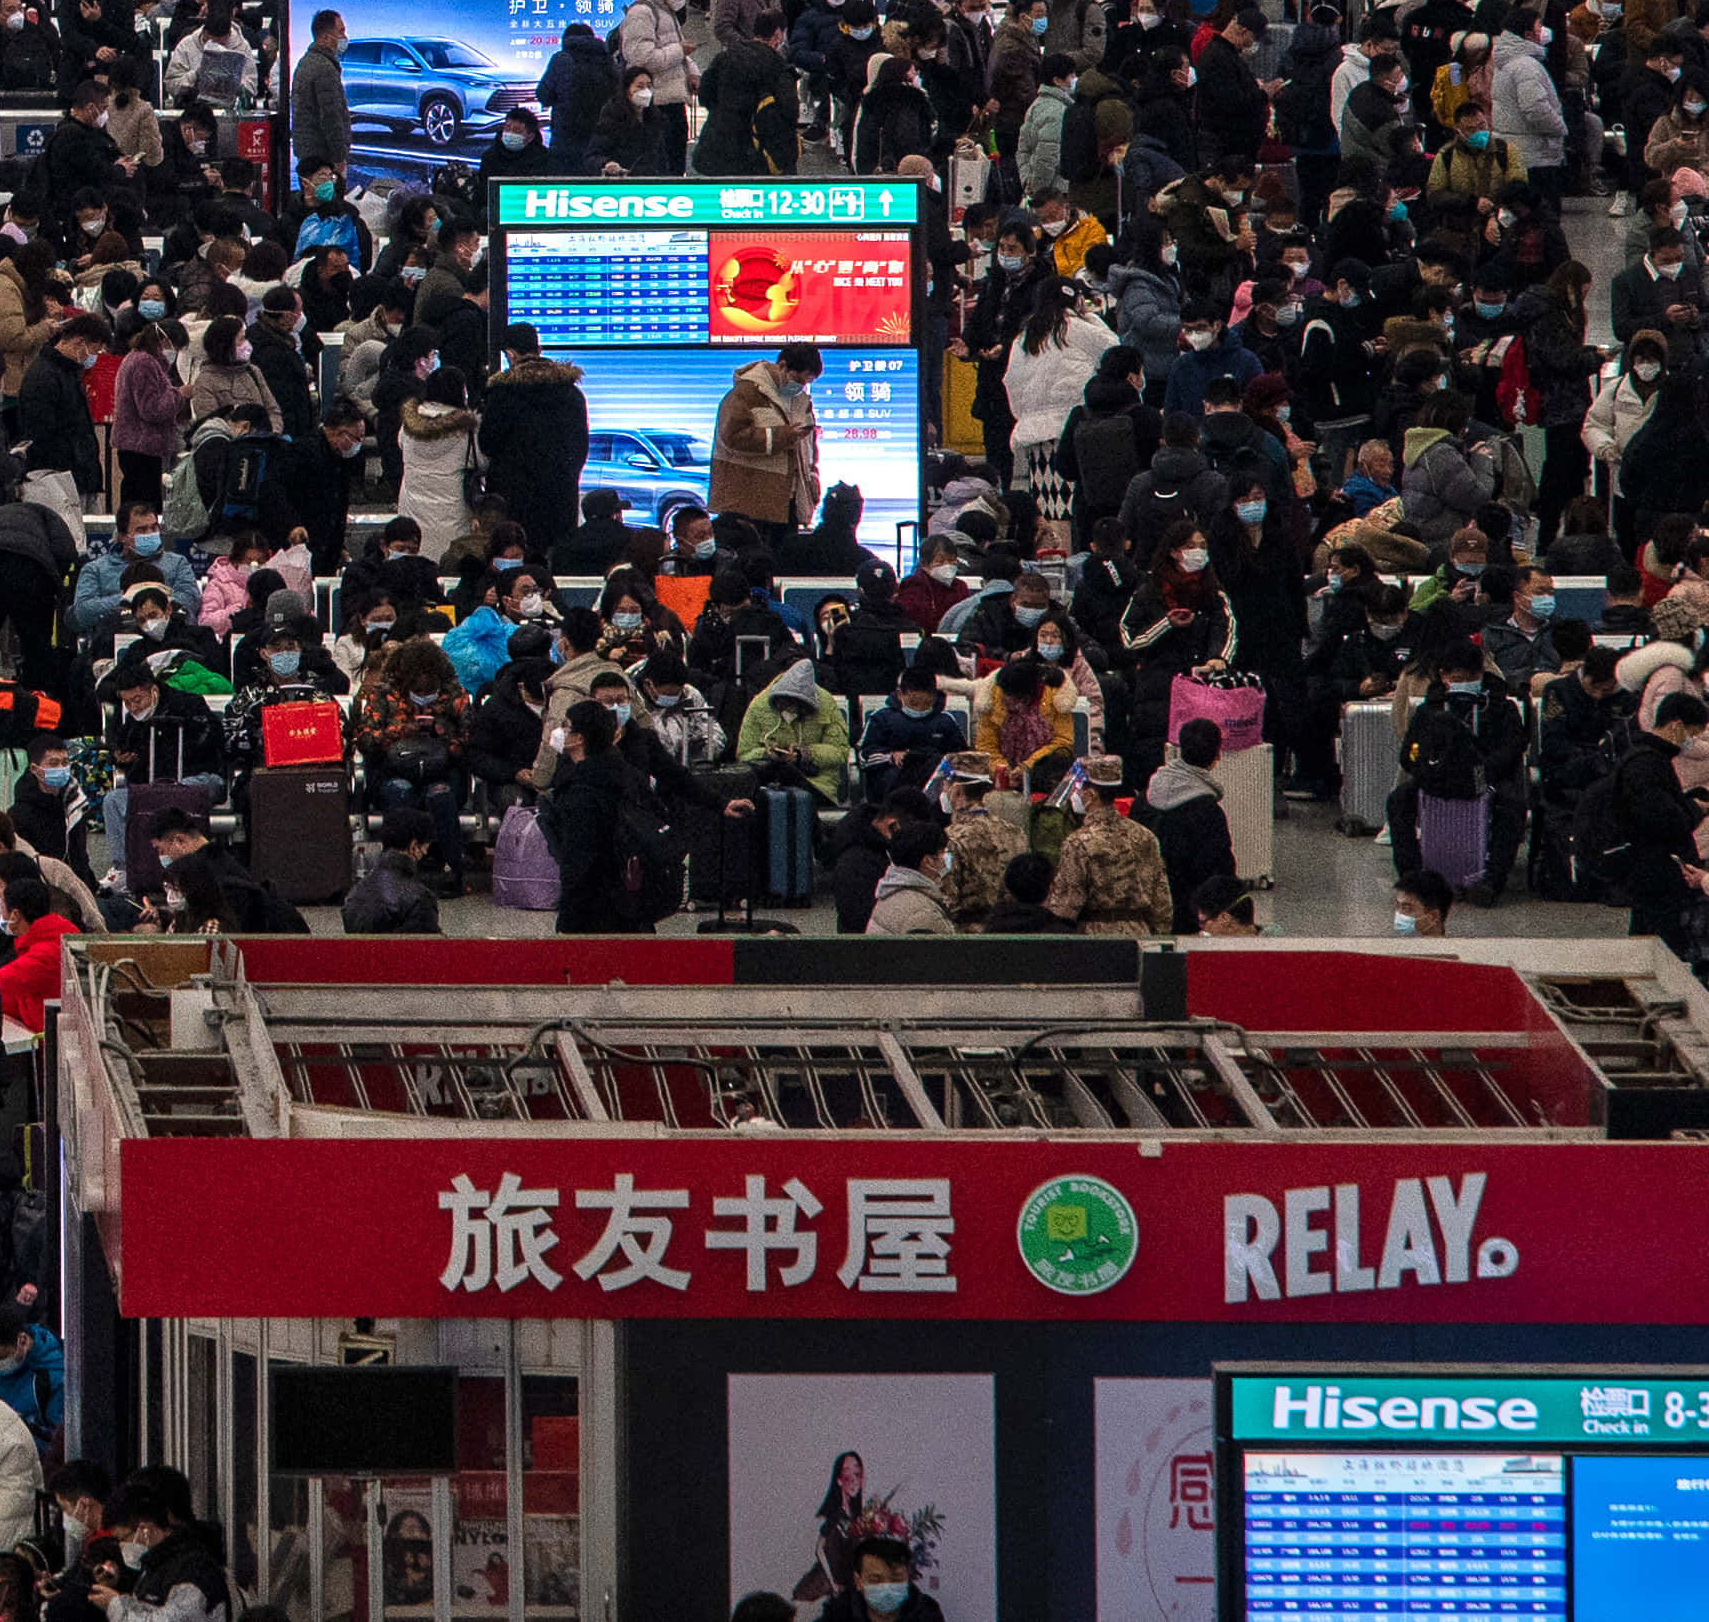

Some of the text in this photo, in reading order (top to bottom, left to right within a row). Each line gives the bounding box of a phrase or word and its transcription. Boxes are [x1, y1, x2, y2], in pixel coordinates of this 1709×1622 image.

[524, 189, 694, 218] Hisense
[768, 190, 824, 215] 12-30
[721, 208, 764, 218] Check in
[1024, 1185, 1063, 1231] TOURIST
[438, 1171, 1488, 1305] 旅友书屋 RELAY
[1273, 1385, 1539, 1430] Hisense
[1580, 1386, 1651, 1417] 检票口
[1582, 1419, 1650, 1435] Check in
